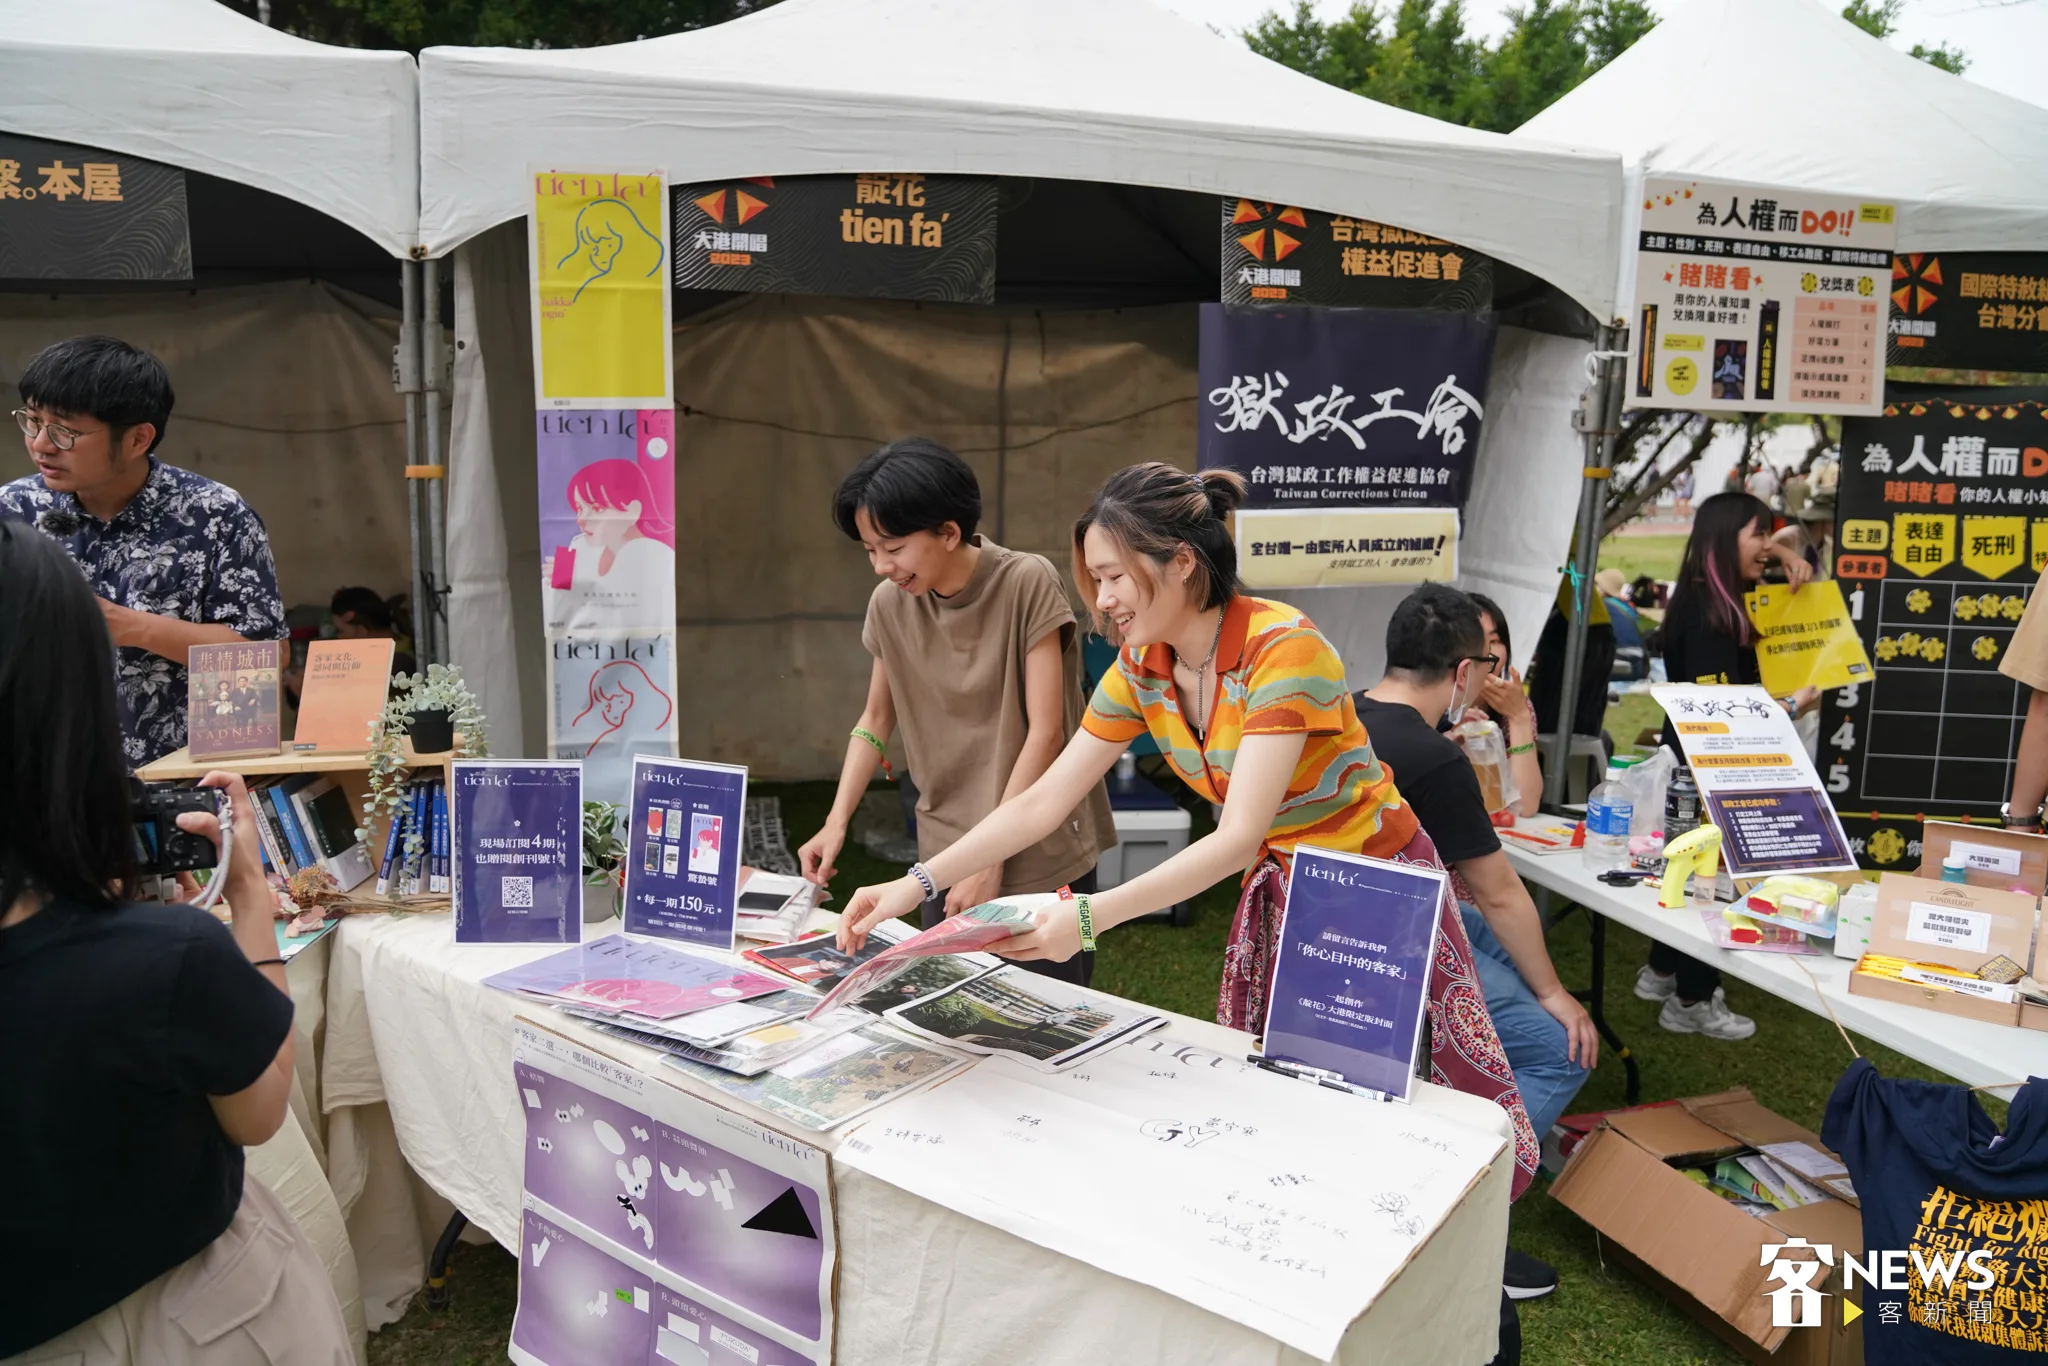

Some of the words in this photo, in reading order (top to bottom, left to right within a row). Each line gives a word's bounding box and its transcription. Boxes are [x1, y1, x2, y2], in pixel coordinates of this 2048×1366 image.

[839, 208, 904, 245] tien
[693, 231, 768, 253] 大港開唱
[710, 253, 753, 266] 2023
[1341, 247, 1465, 281] 權益促進會
[1237, 267, 1302, 287] 大港開唱
[1679, 263, 1751, 291] 賭賭看
[1250, 465, 1451, 486] 台灣獄政工作權益促進協會
[1273, 487, 1317, 499] Taiwan
[1321, 487, 1389, 499] Corrections
[1392, 487, 1429, 500] Union
[1884, 480, 1958, 505] 賭賭看
[1848, 527, 1882, 545] 主題
[1904, 521, 1944, 541] 表達
[1906, 544, 1943, 563] 自由
[1971, 534, 2015, 557] 死刑
[196, 648, 273, 673] 悲情城市
[196, 725, 275, 740] SADNESS
[1830, 722, 1856, 751] 4
[1826, 764, 1850, 793] 5
[1930, 895, 1975, 909] CANDLELIGHT
[1078, 900, 1093, 941] MEGAPORT
[1321, 931, 1388, 954] 請留言告訴我們
[1297, 941, 1407, 980] 「你心目中的客家」
[1911, 1223, 1973, 1253] Fight
[1982, 1239, 2014, 1257] for
